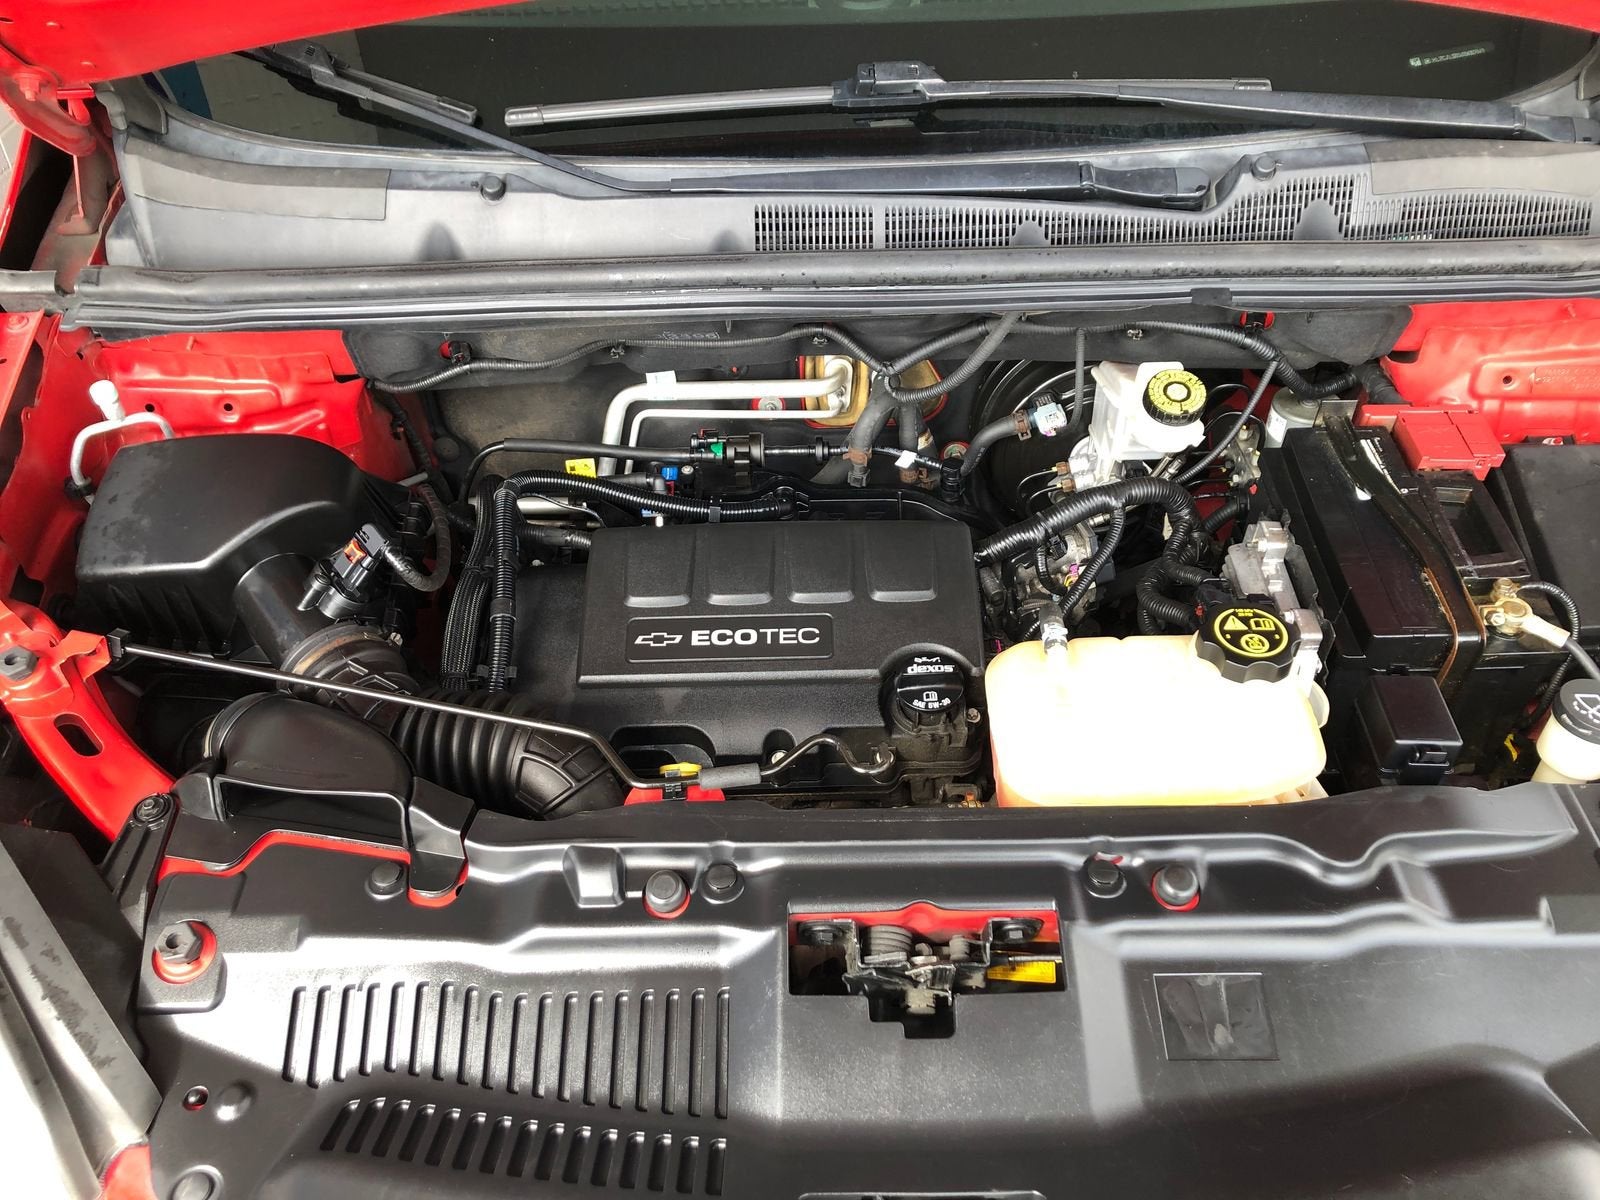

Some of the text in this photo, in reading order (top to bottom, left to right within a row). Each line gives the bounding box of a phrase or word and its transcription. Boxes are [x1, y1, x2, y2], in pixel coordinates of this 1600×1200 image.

[690, 627, 820, 647] ECOTEC
[907, 663, 955, 674] dexos
[912, 699, 926, 709] SAE
